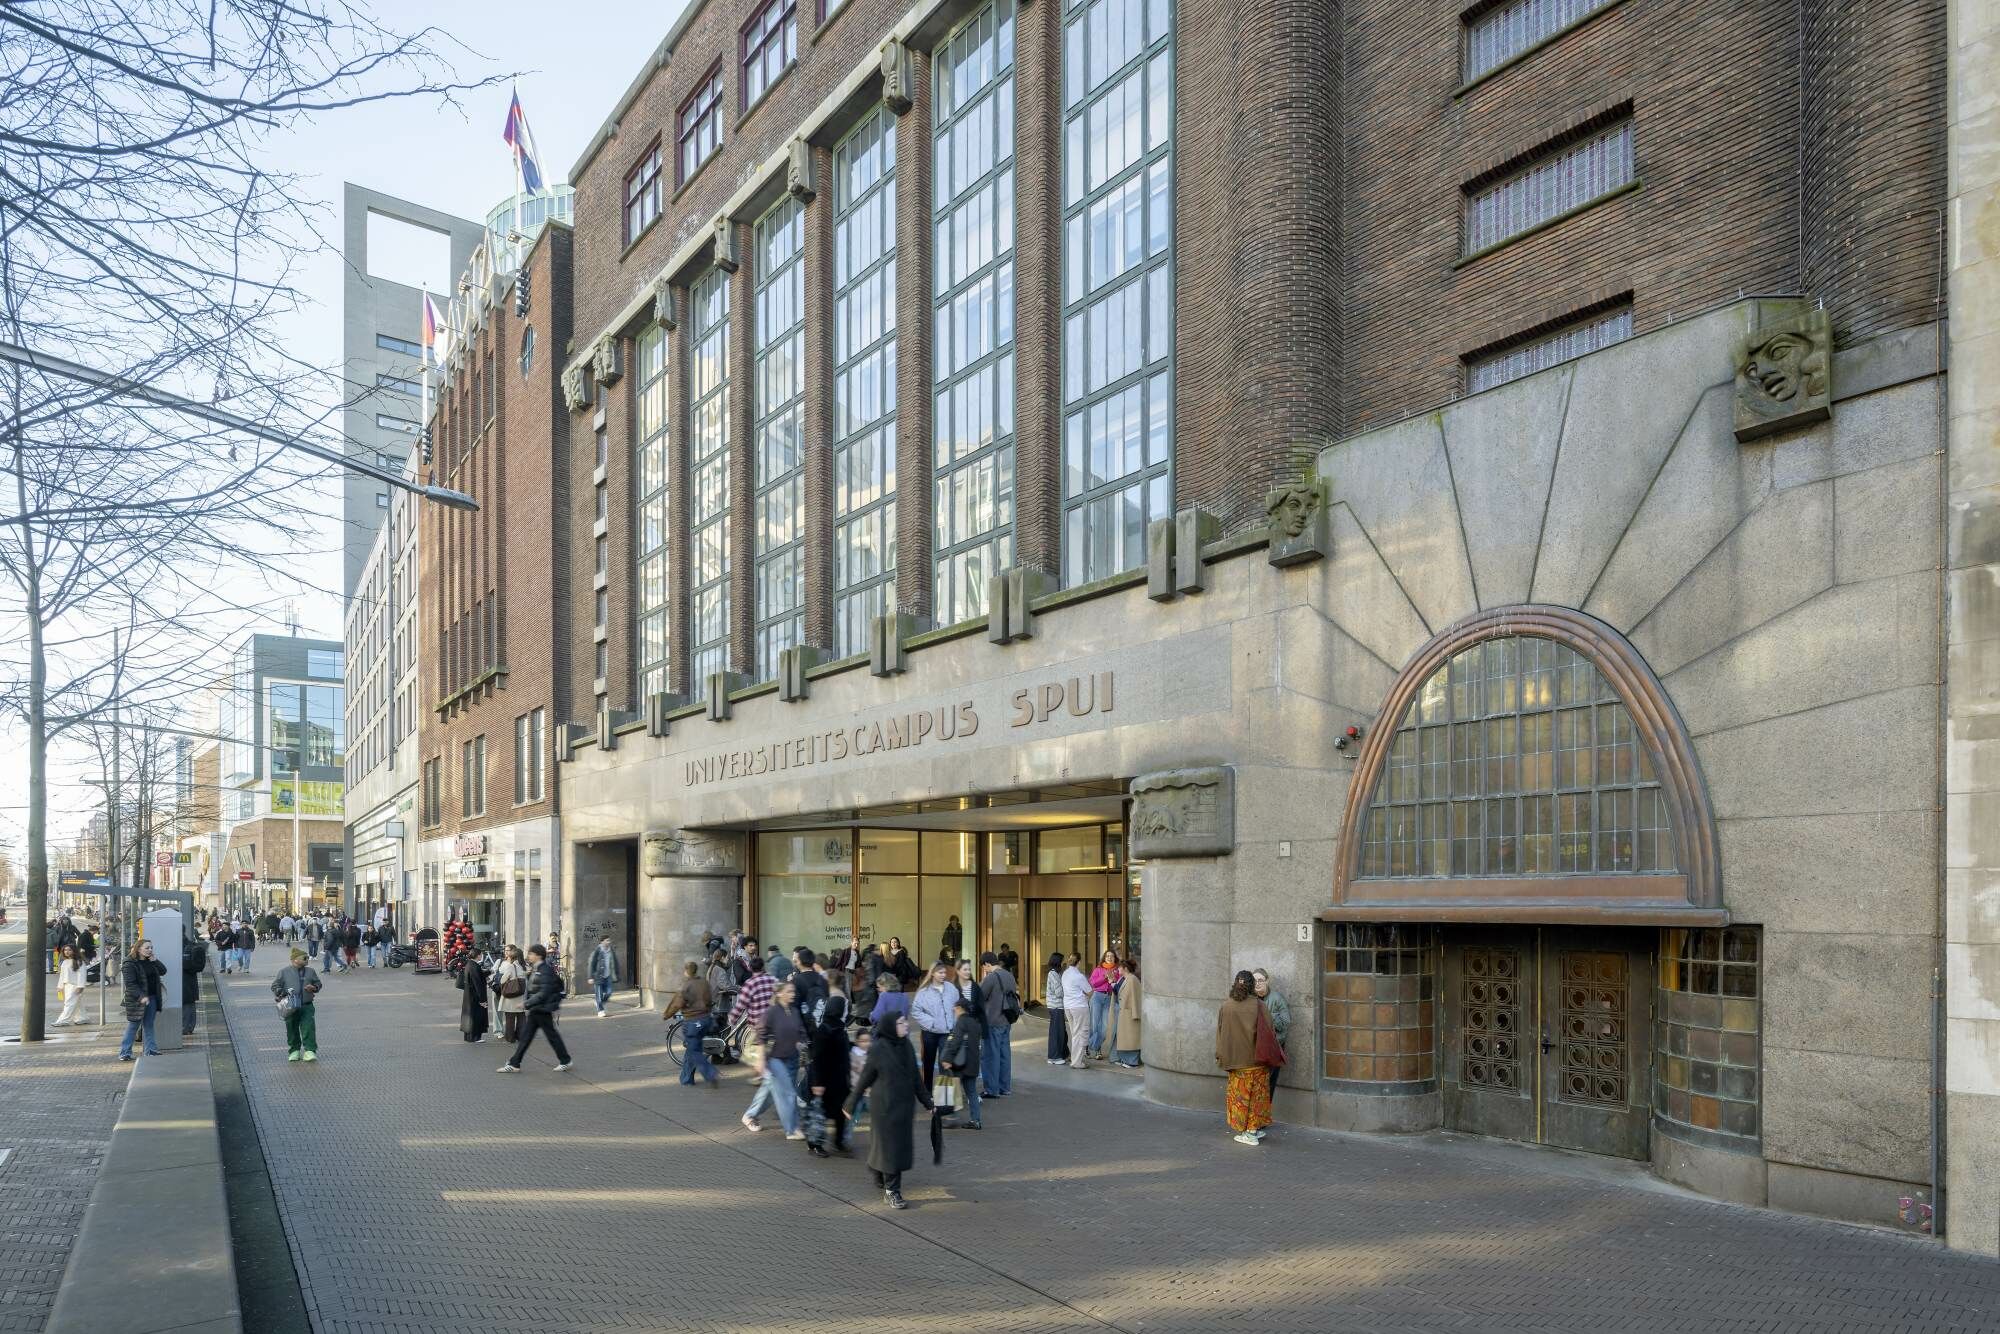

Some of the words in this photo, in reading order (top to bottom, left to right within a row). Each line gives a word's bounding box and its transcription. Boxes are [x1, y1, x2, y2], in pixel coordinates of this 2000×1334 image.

[685, 700, 979, 787] UNIVERSITEITSCAMPUS
[1010, 671, 1115, 728] SPUI
[833, 876, 869, 885] TUDlft
[1302, 926, 1308, 940] 3
